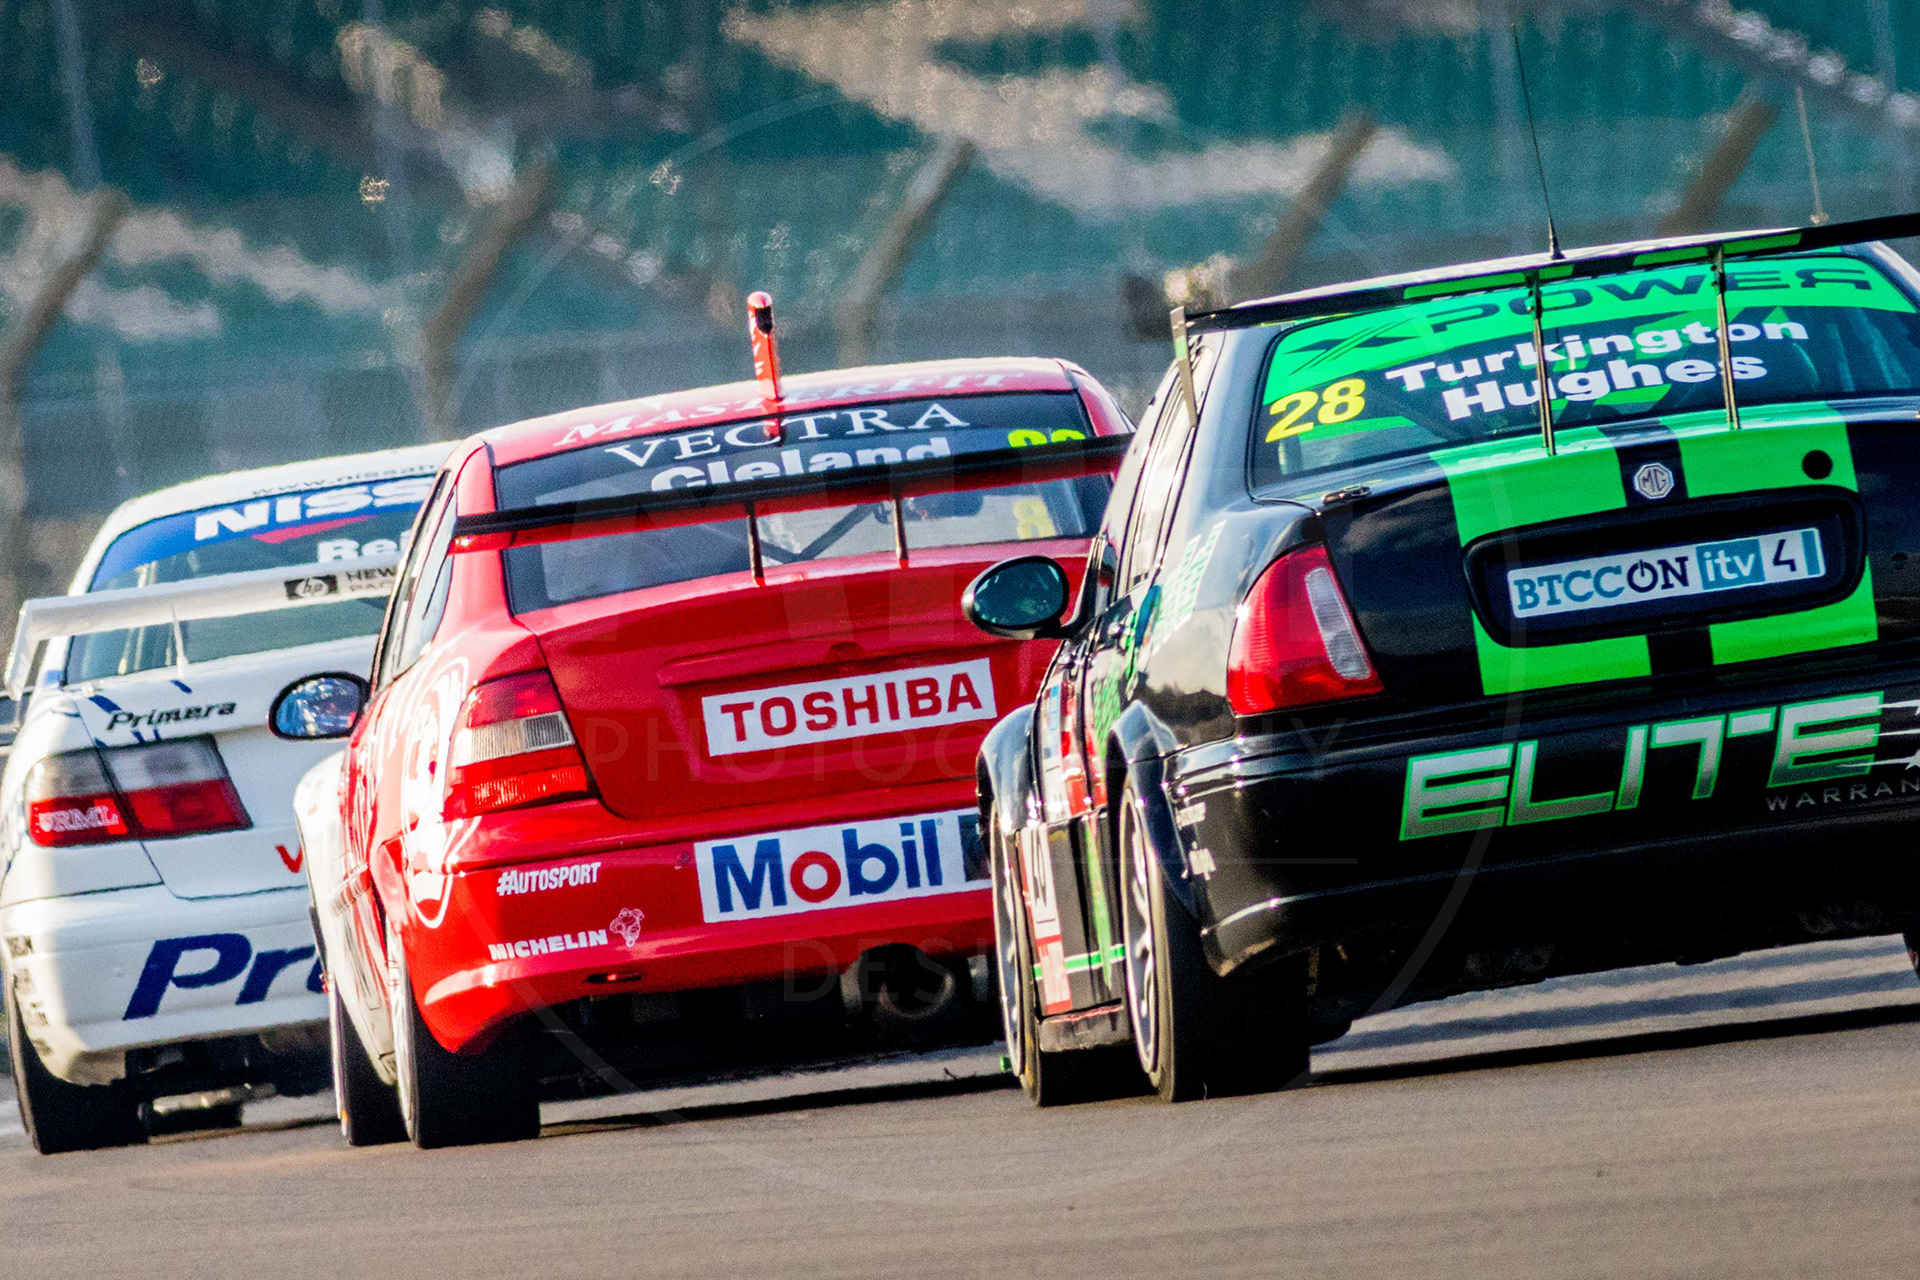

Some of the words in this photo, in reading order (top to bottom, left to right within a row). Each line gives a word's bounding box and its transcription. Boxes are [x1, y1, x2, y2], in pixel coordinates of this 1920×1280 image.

[1385, 318, 1809, 392] Turkington
[1441, 354, 1768, 421] Hughes
[603, 402, 971, 467] VECTRA
[1265, 378, 1366, 443] 28
[1701, 549, 1756, 583] itv
[1773, 538, 1798, 572] 4
[106, 702, 238, 732] Primera
[720, 672, 983, 742] TOSHIBA
[1398, 691, 1885, 841] ELITE
[496, 861, 602, 897] #AUTOSPORT
[711, 818, 943, 913] Mobil
[488, 928, 609, 961] MICHELIN
